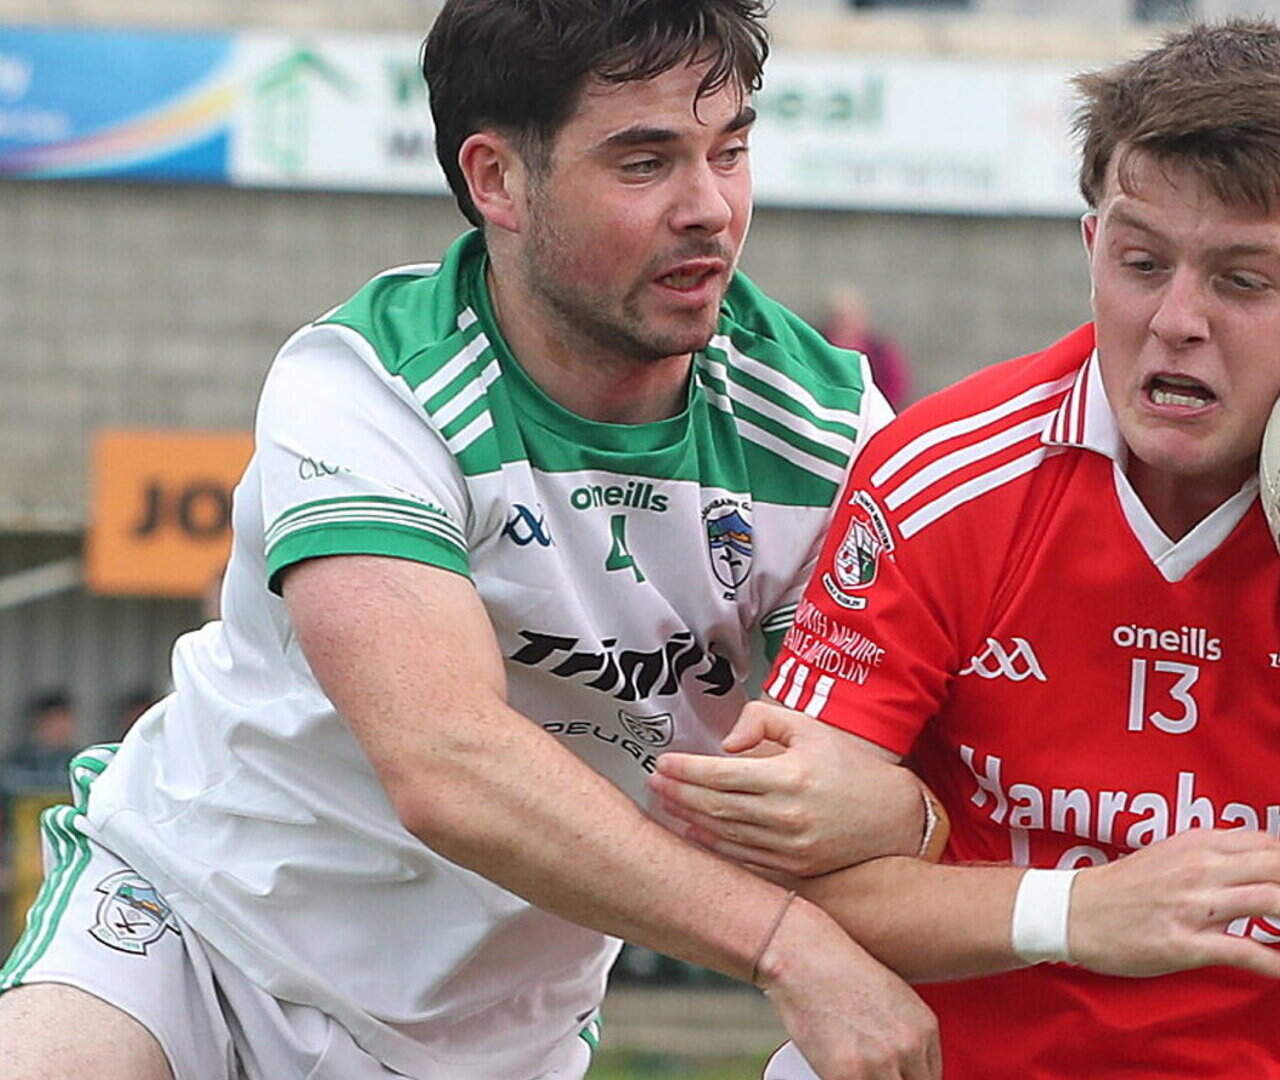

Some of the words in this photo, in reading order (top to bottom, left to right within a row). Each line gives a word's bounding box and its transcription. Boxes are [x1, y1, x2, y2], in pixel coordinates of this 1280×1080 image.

[132, 478, 233, 541] JO
[605, 514, 645, 583] 4
[1113, 623, 1222, 661] o'neills
[1128, 658, 1200, 734] 13
